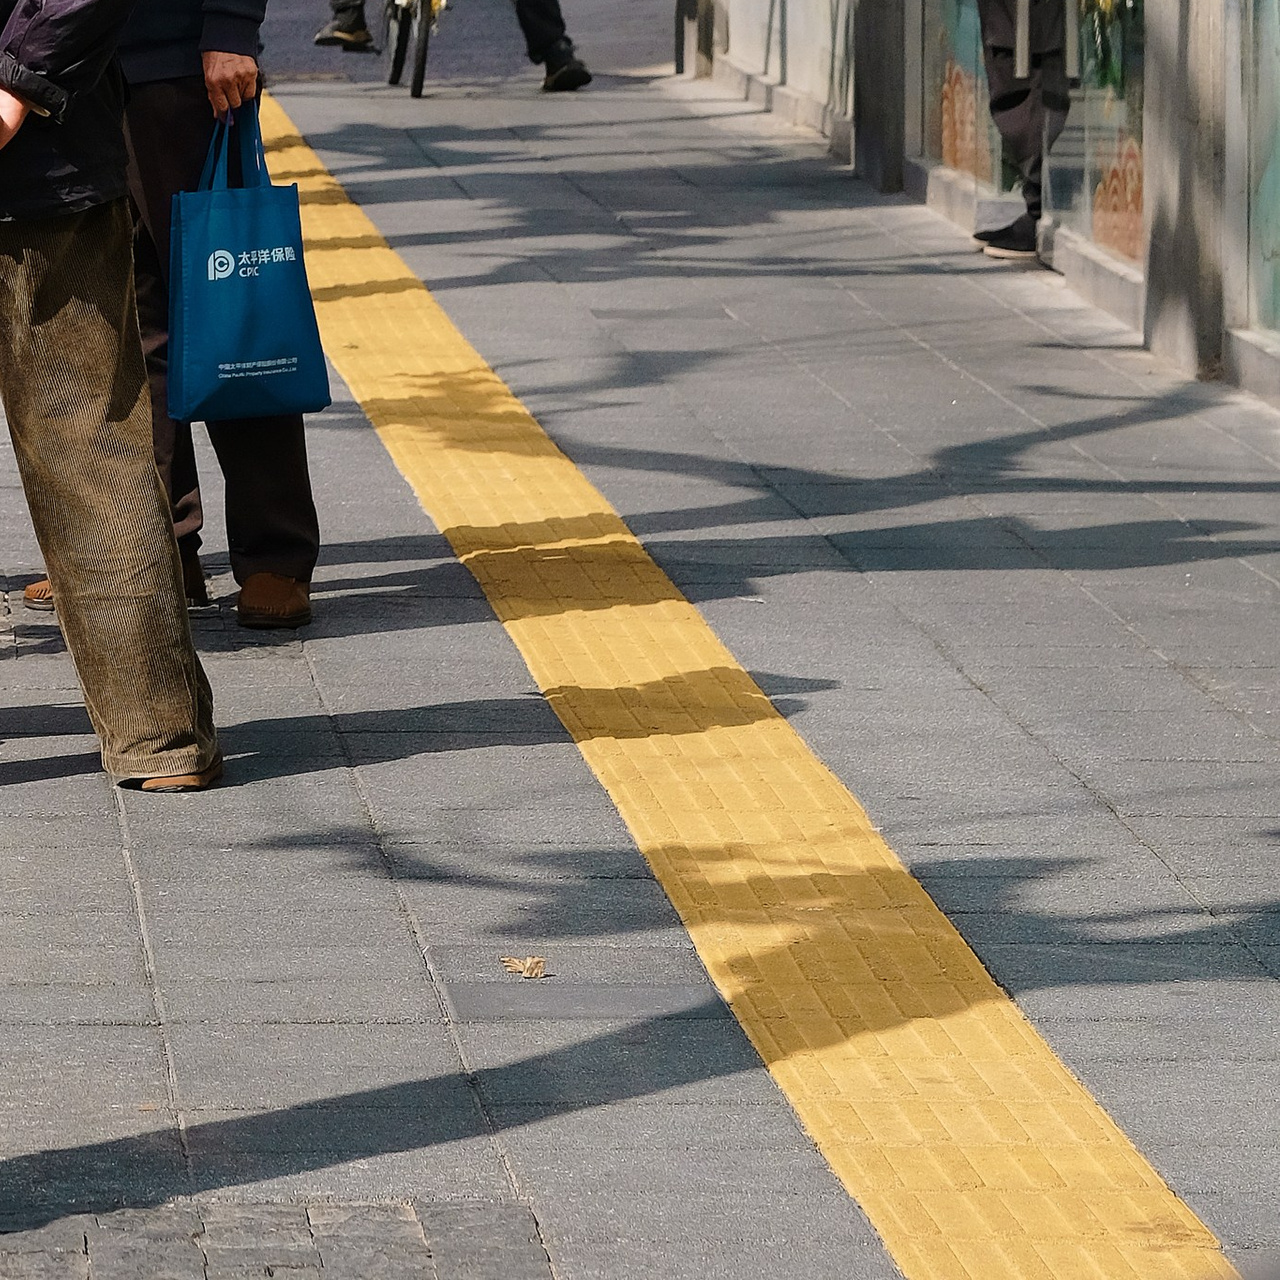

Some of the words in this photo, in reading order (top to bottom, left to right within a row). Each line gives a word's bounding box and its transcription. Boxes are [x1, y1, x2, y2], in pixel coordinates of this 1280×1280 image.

[238, 246, 296, 266] 太平洋保险
[239, 266, 260, 278] CPIC
